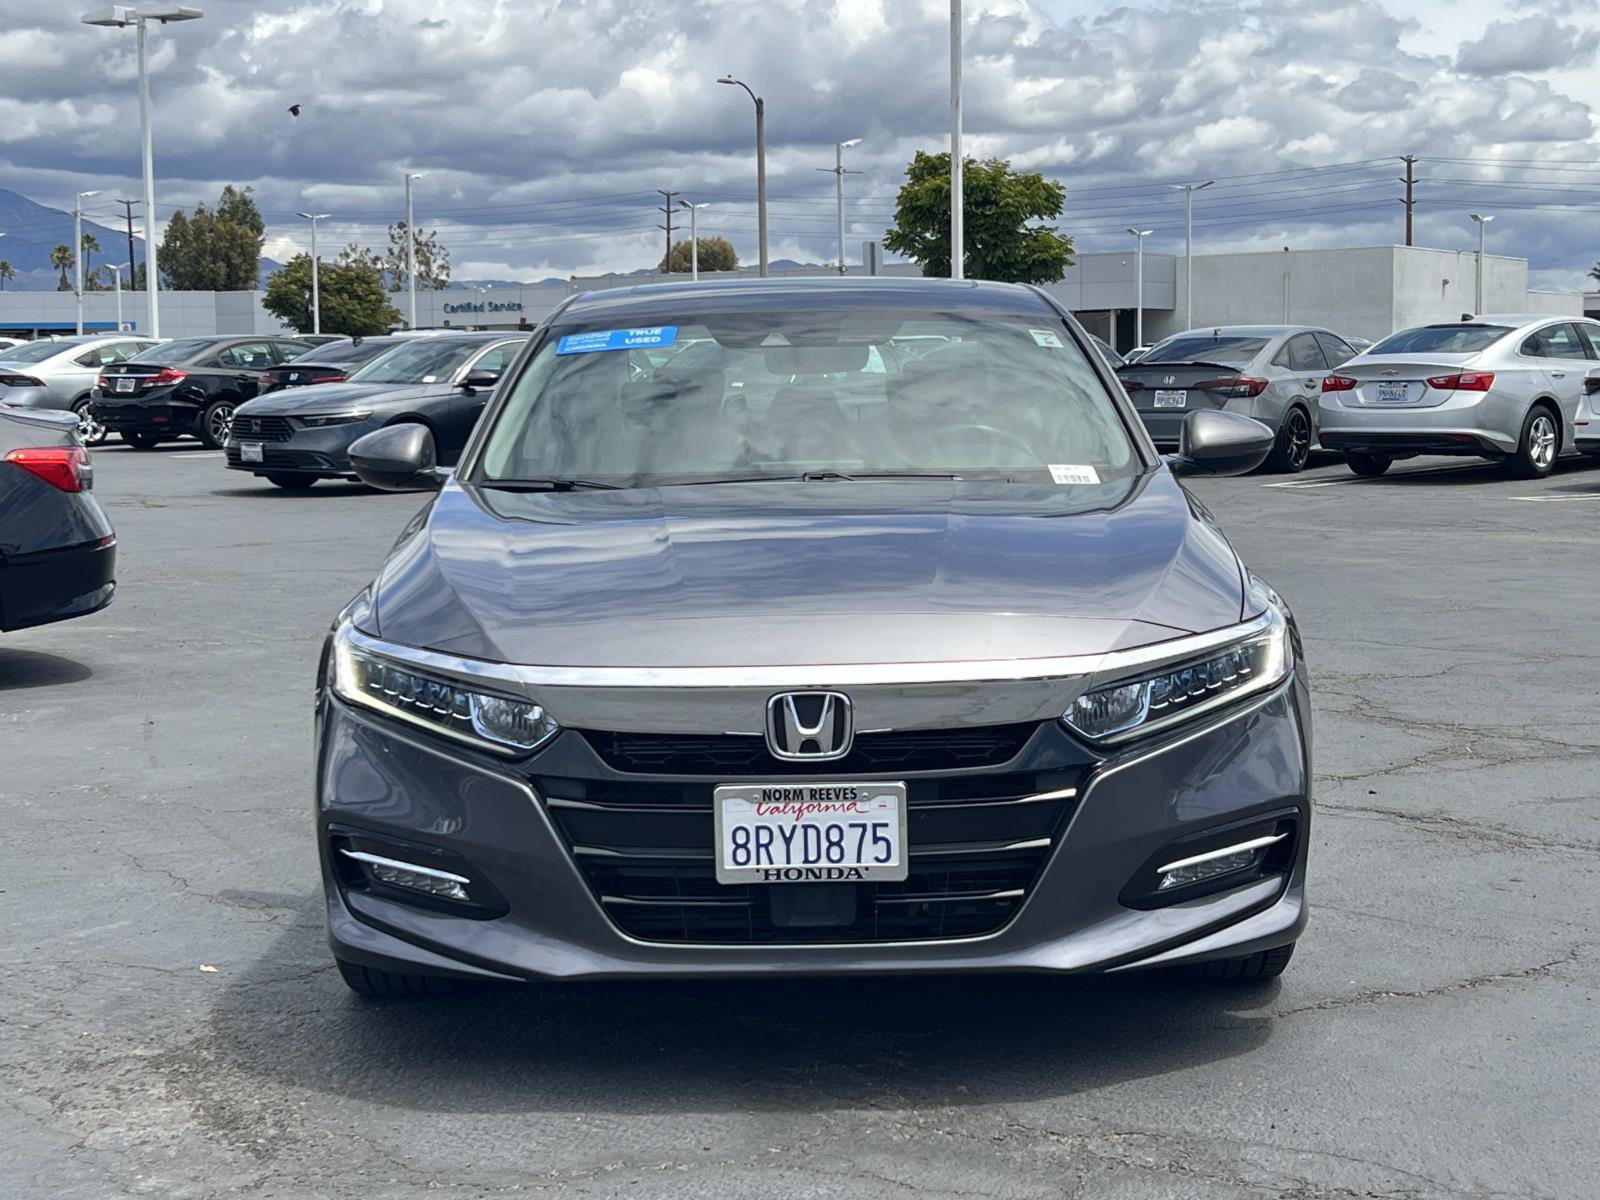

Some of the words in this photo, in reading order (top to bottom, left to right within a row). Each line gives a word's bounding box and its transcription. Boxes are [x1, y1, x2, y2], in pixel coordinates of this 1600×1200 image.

[443, 302, 485, 313] Certified
[488, 301, 523, 312] Service
[629, 328, 662, 336] TRUE
[762, 788, 804, 801] NORM
[810, 787, 857, 801] REEVES
[756, 801, 870, 822] California
[731, 822, 892, 866] 8RYD875
[763, 867, 864, 881] HONDA
